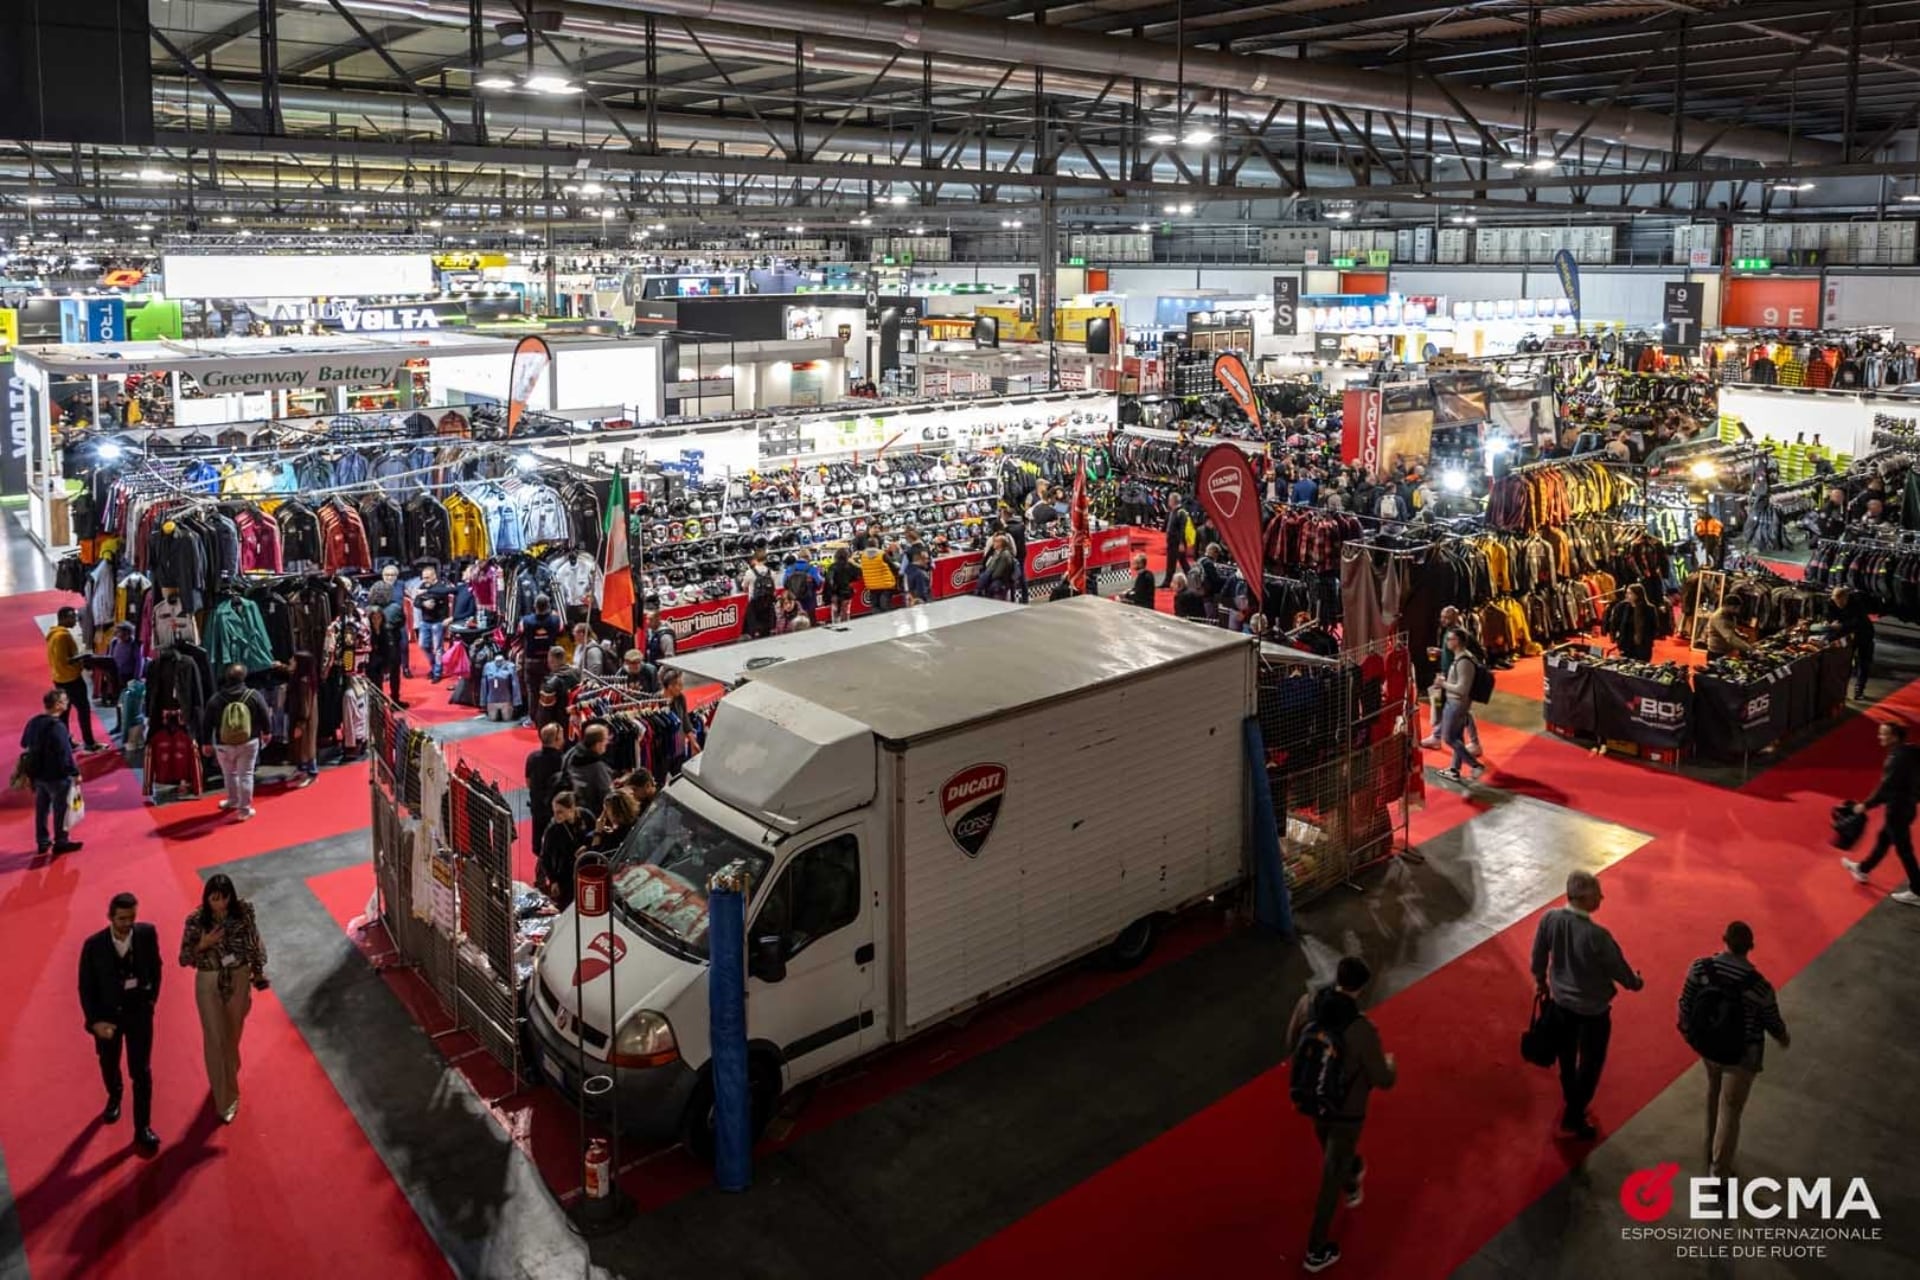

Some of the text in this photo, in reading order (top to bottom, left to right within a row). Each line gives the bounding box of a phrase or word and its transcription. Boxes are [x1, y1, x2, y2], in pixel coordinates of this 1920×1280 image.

[1281, 282, 1288, 293] 9
[1677, 288, 1688, 302] 9
[1022, 298, 1033, 315] R
[1278, 304, 1293, 326] S
[1763, 307, 1805, 326] 9 E
[340, 308, 439, 331] VOLTA
[1671, 317, 1694, 345] T
[203, 365, 395, 387] Greenway Battery
[947, 773, 1000, 801] DUCATI
